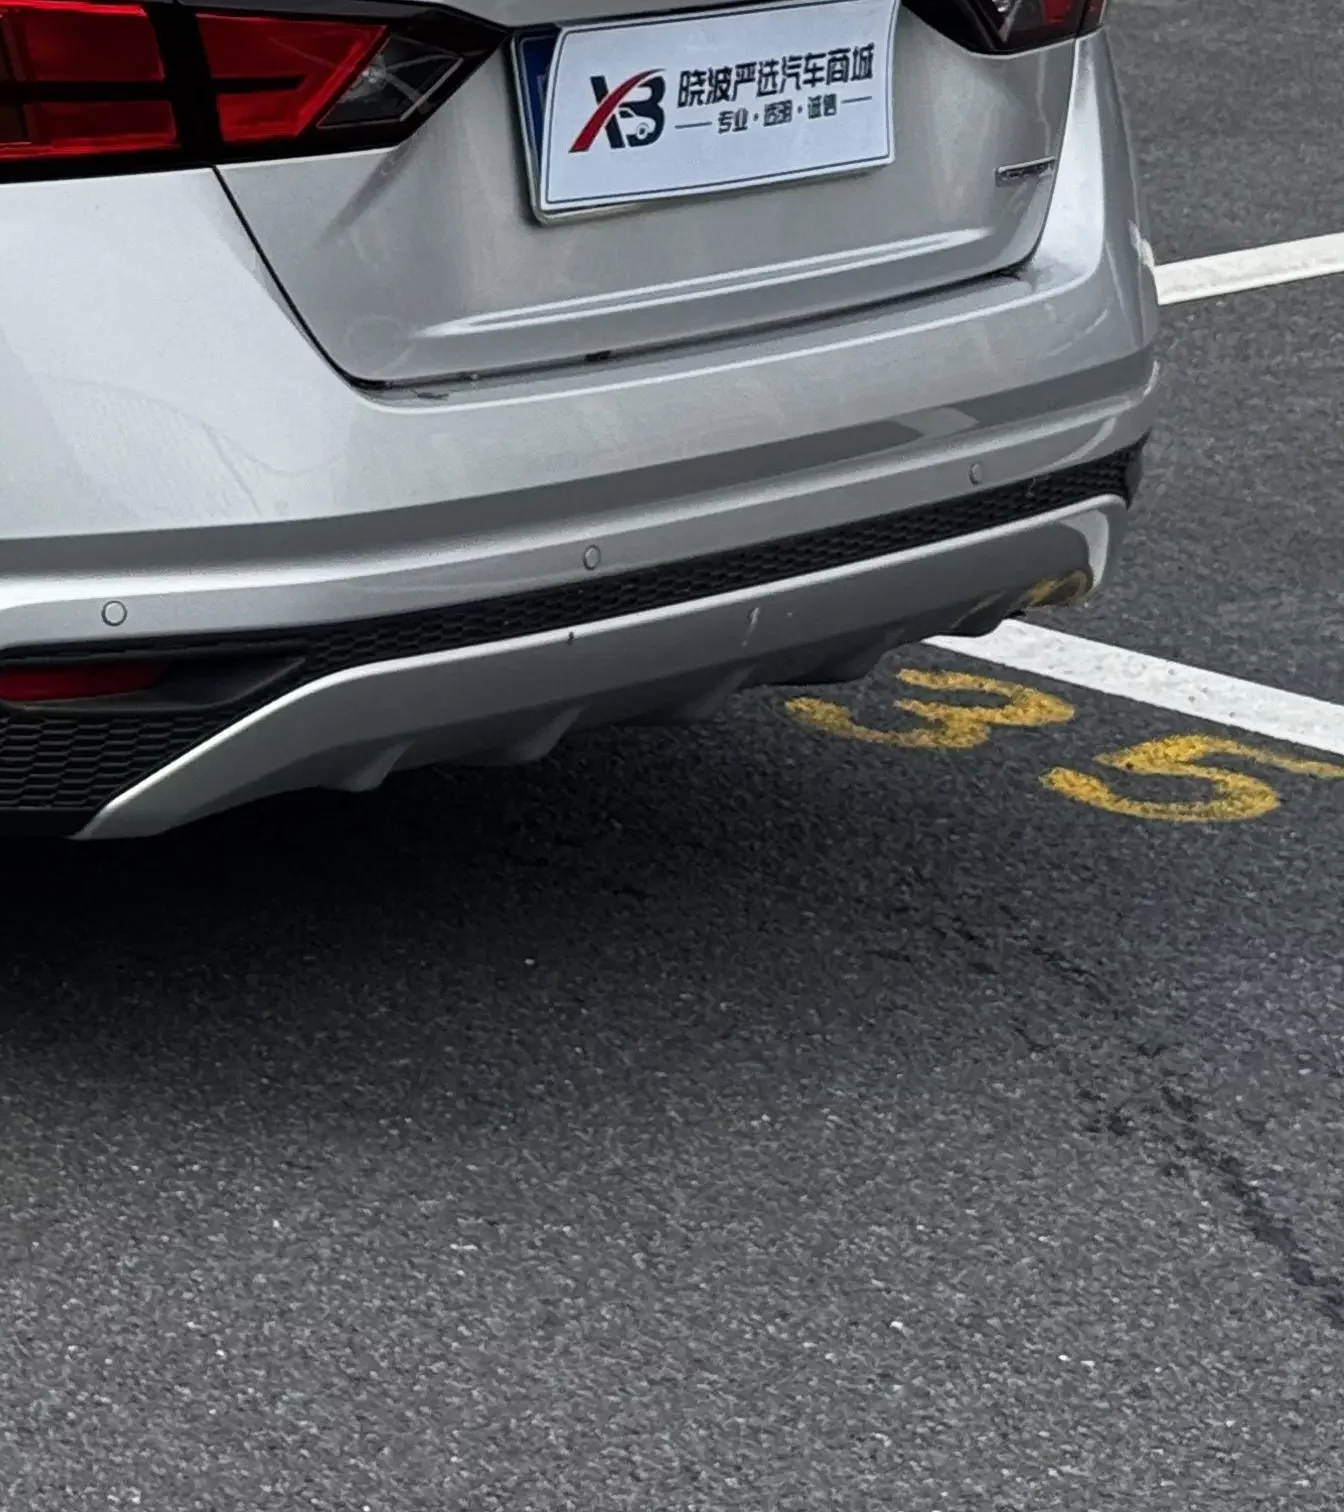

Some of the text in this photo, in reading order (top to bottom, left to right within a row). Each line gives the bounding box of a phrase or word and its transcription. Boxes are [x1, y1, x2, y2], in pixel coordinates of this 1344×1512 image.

[676, 42, 876, 109] 晓波严选汽车商城
